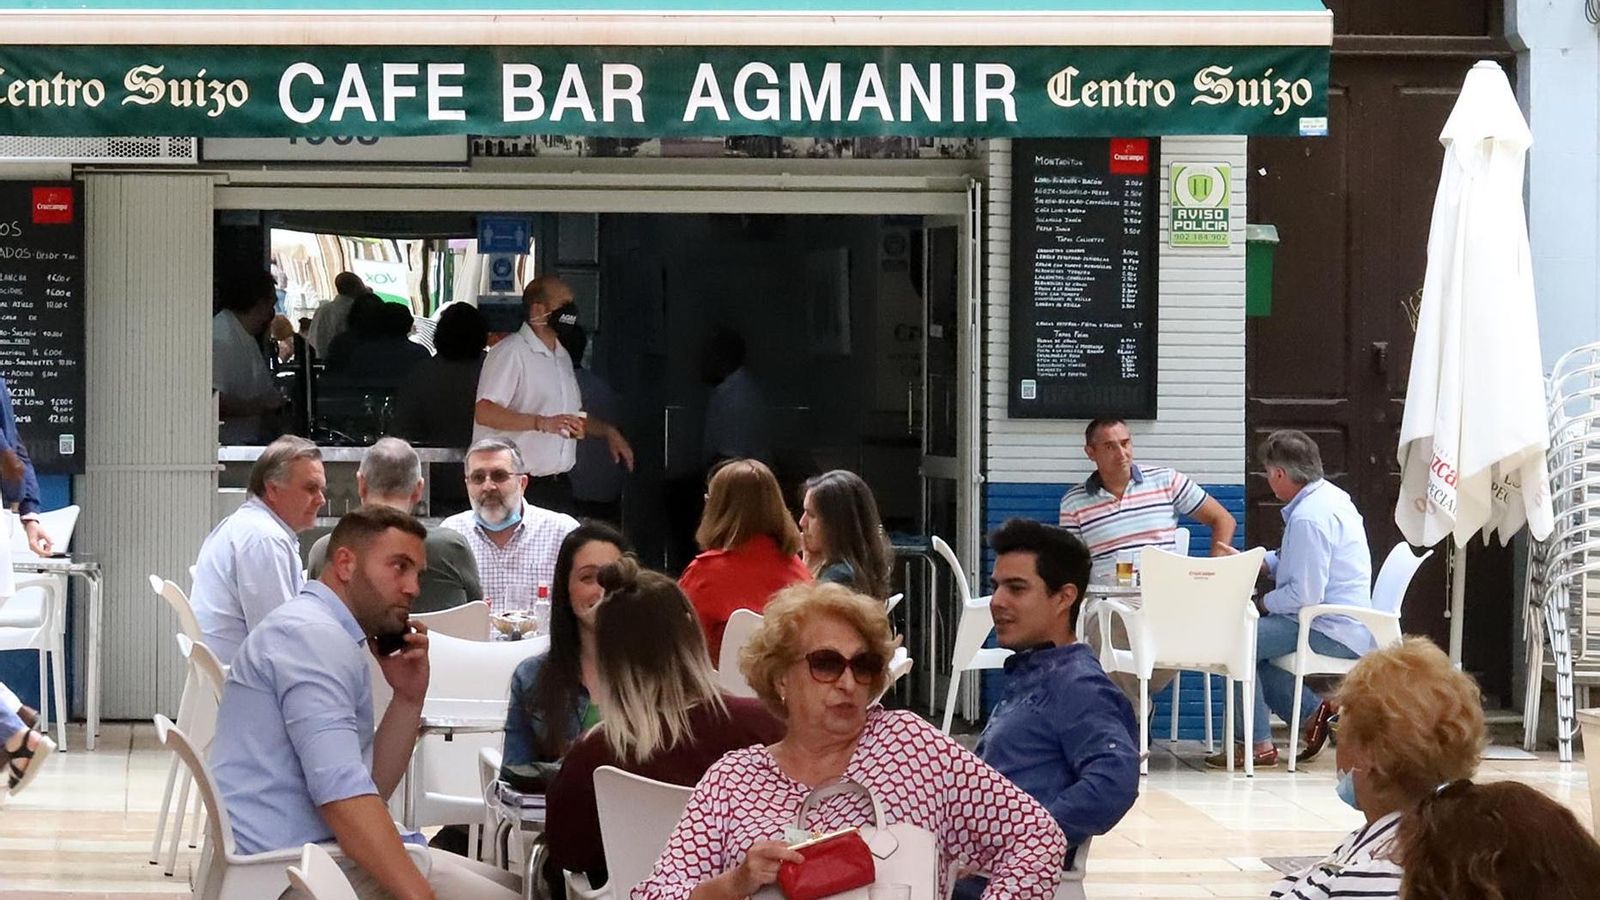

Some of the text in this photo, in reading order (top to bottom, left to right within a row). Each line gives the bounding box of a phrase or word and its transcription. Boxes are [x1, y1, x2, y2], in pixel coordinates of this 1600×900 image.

[0, 69, 106, 108] entro
[278, 61, 1018, 124] CAFE BAR AGMANIR
[1046, 65, 1176, 108] Centro
[1174, 221, 1228, 231] POLICIA
[1178, 209, 1224, 220] AVISO
[1174, 233, 1190, 241] 902
[1210, 233, 1228, 241] 902
